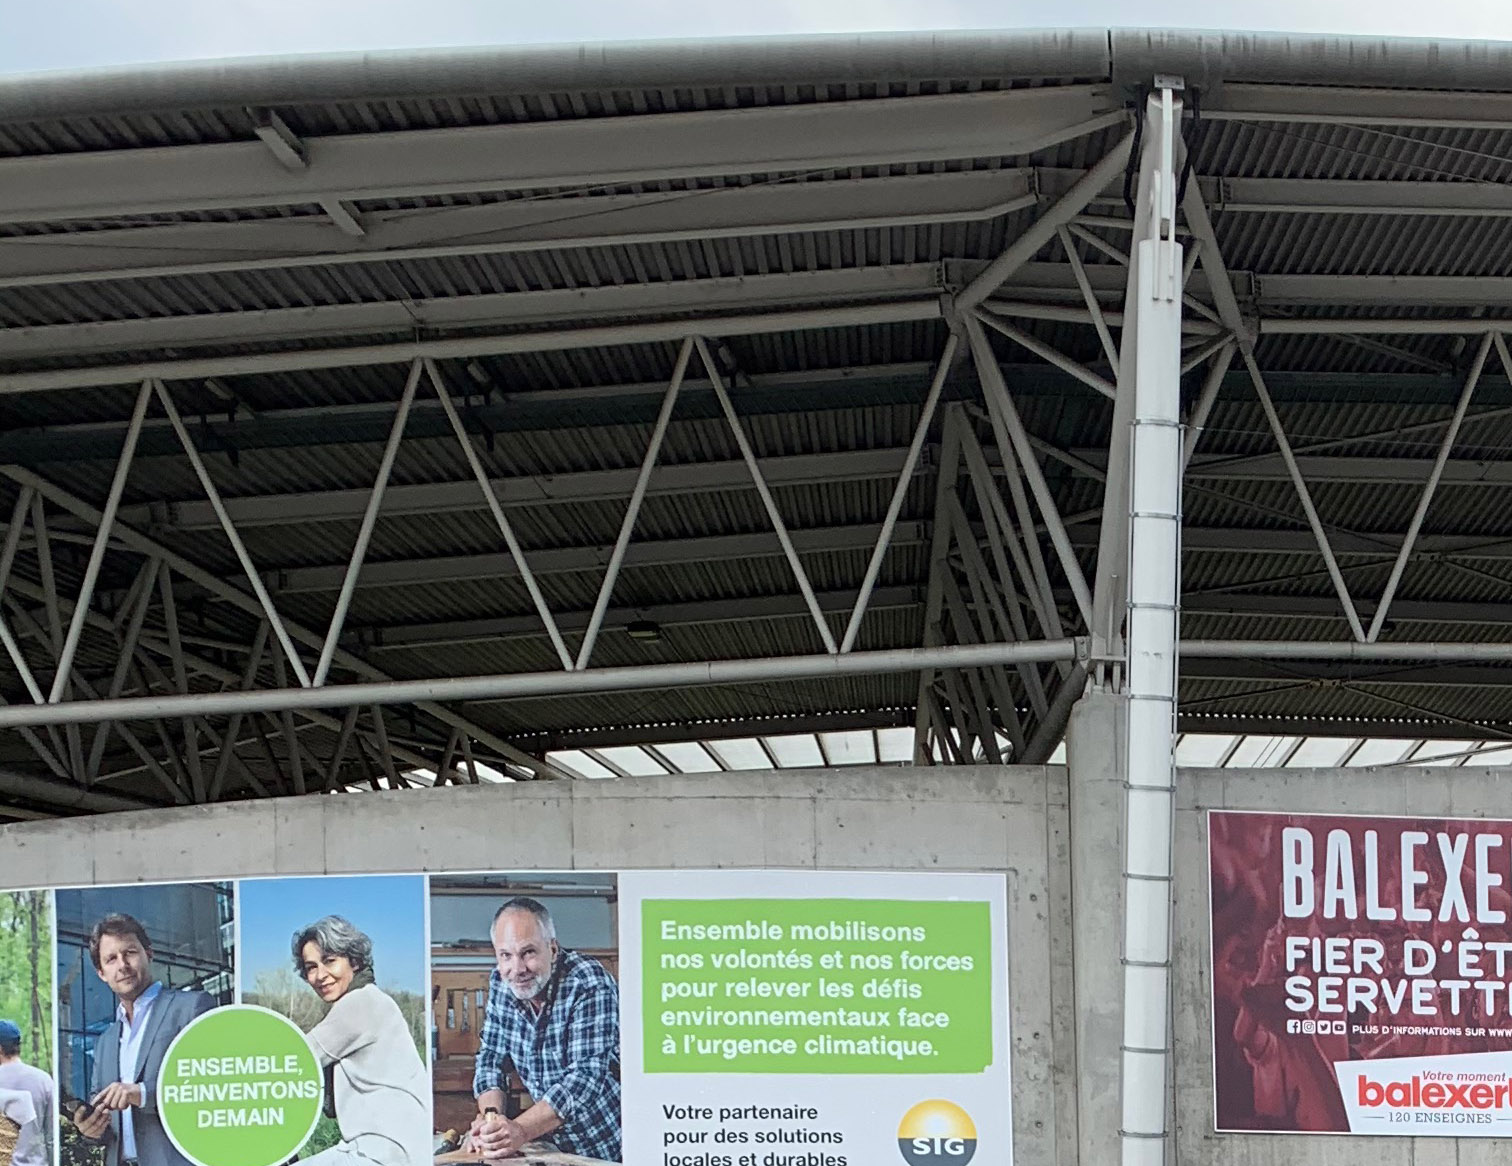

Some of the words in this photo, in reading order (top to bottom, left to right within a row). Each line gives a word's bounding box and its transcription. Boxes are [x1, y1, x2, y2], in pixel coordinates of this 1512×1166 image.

[661, 920, 782, 941] Ensemble
[790, 921, 926, 942] mobilisons
[661, 952, 704, 970] nos
[711, 948, 813, 970] volontés
[819, 951, 844, 970] et
[850, 954, 893, 971] nos
[900, 950, 974, 971] forces
[1286, 936, 1385, 975] FIER
[661, 981, 716, 1003] pour
[725, 978, 812, 998] relever
[818, 979, 855, 999] les
[862, 979, 922, 1000] défis
[661, 1007, 890, 1029] environnementaux
[898, 1007, 950, 1028] face
[1352, 1025, 1379, 1035] PLUS
[1381, 1025, 1462, 1037] D'INFORMATIONS
[1464, 1027, 1486, 1037] SUR
[661, 1035, 676, 1055] à
[684, 1034, 797, 1060] l'urgence
[804, 1036, 940, 1061] climatique.
[177, 1055, 303, 1077] ENSEMBLE,
[1422, 1070, 1456, 1082] Votre
[1457, 1071, 1507, 1083] moment
[163, 1079, 318, 1103] RÉINVENTONS
[197, 1107, 284, 1128] DEMAIN
[662, 1105, 714, 1120] Votre
[719, 1104, 818, 1125] partenaire
[1388, 1112, 1411, 1124] 120
[1415, 1112, 1493, 1125] ENSEIGNES
[664, 1131, 709, 1148] pour
[714, 1128, 750, 1145] des
[755, 1128, 844, 1145] solutions
[912, 1137, 965, 1156] SIG
